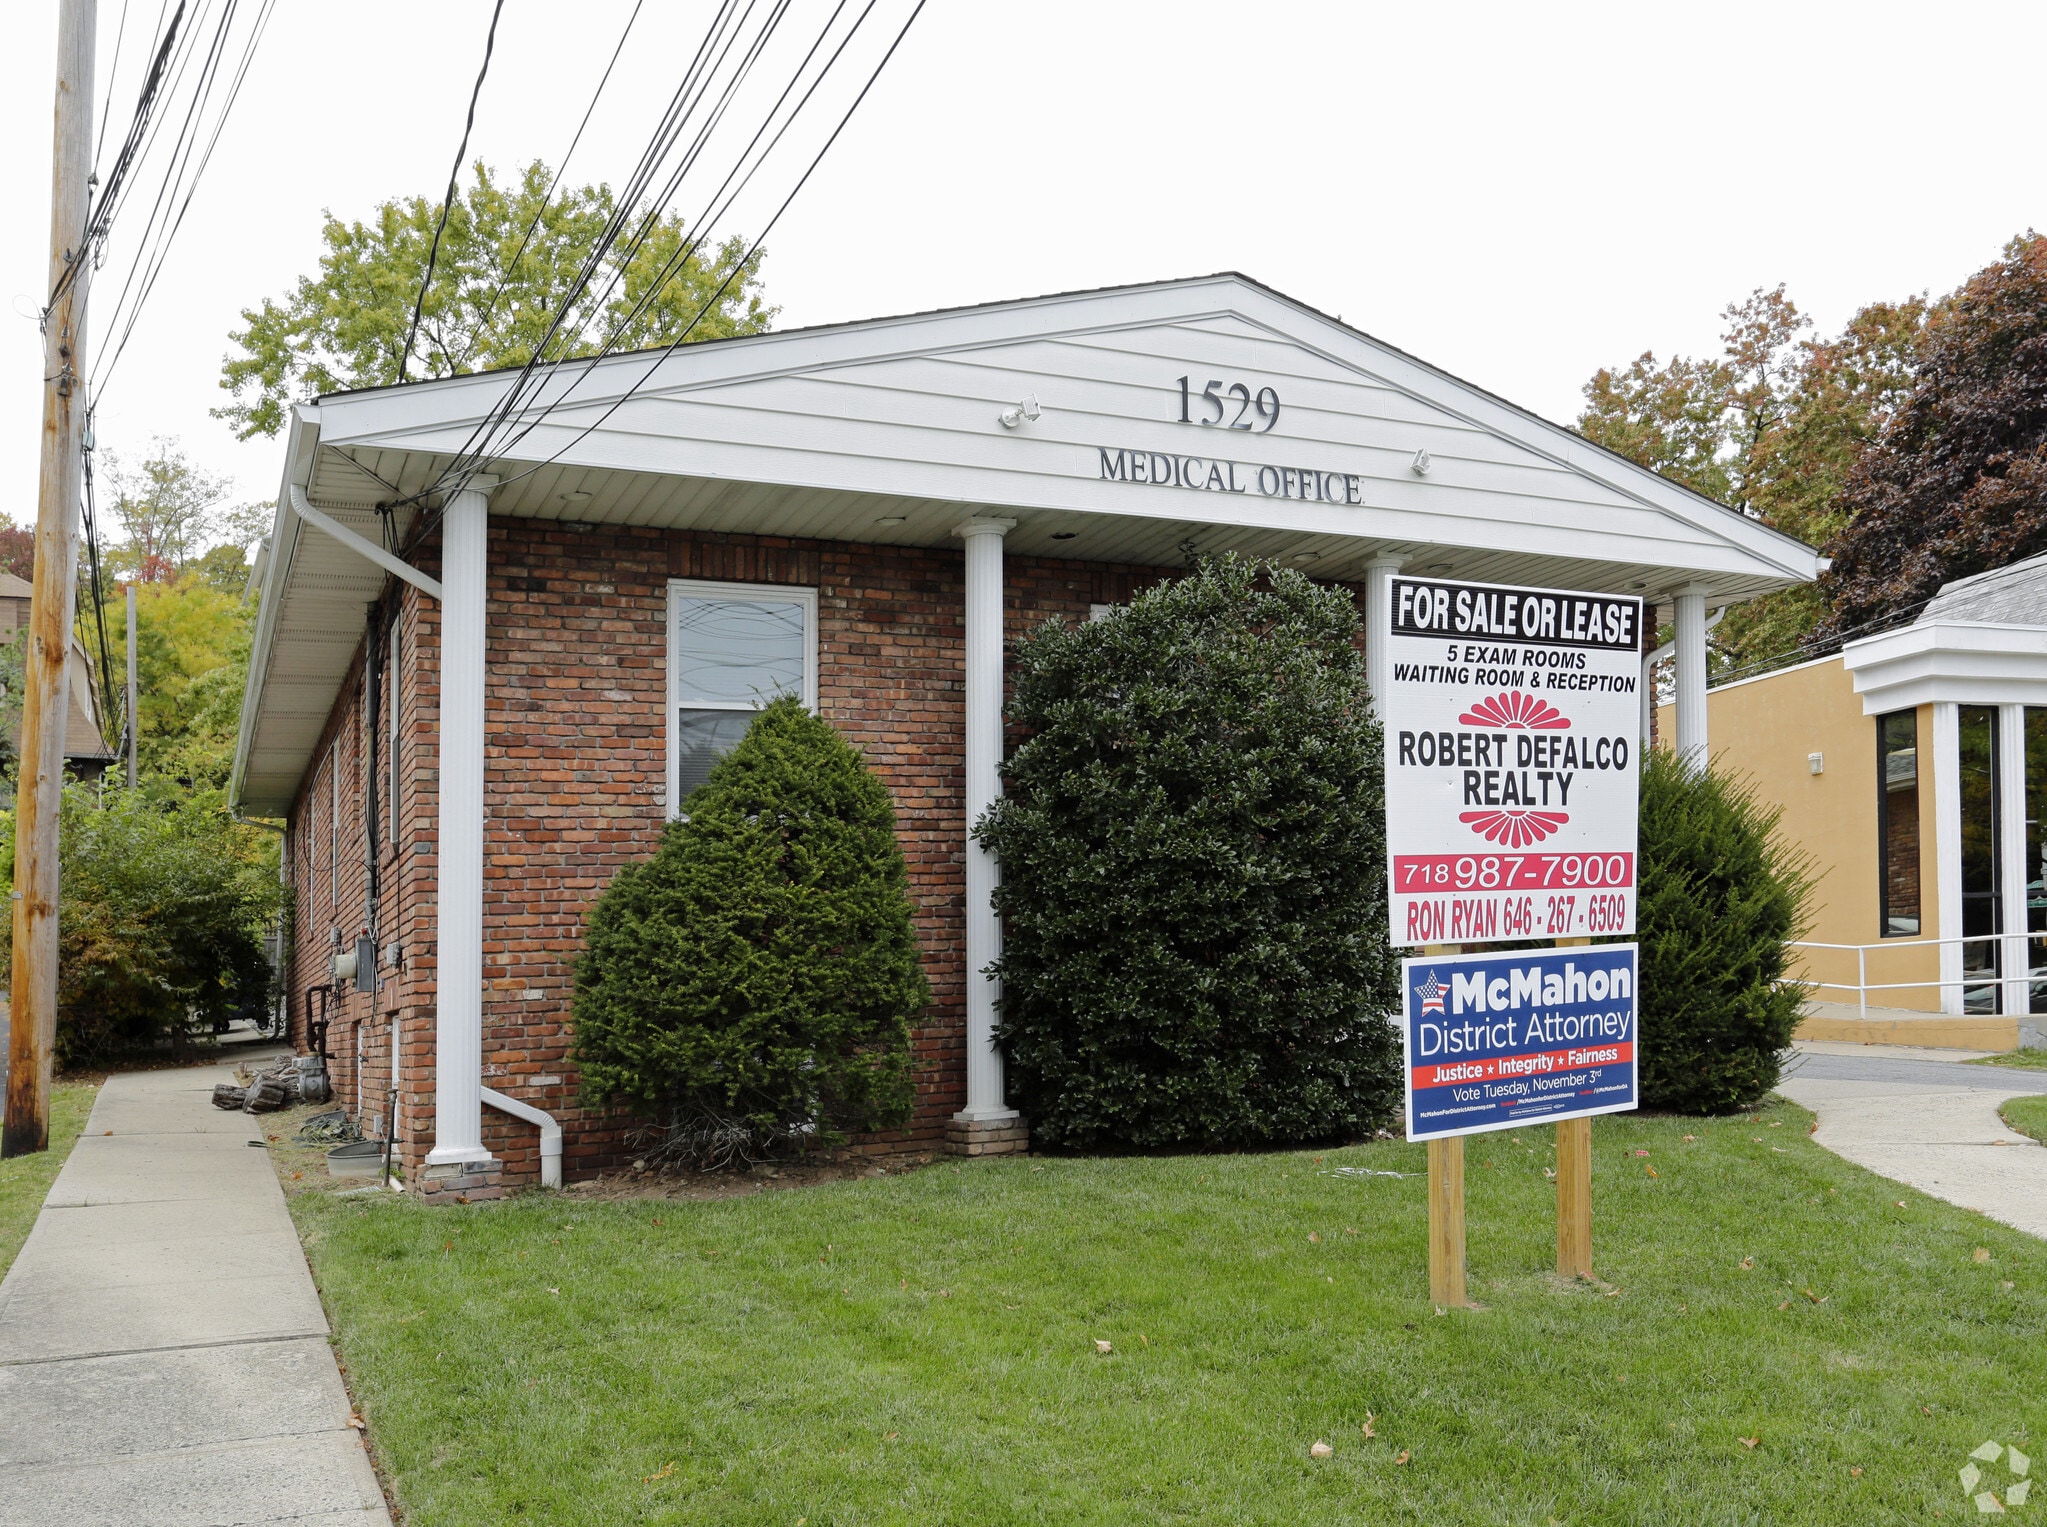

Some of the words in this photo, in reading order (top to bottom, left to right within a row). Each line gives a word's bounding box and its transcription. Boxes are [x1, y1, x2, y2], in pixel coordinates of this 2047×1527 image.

[1177, 375, 1281, 434] 1529
[1098, 447, 1246, 493] MEDICAL
[1258, 465, 1362, 504] OFFICE
[1399, 586, 1449, 629] FOR
[1455, 590, 1518, 635] SALE
[1522, 596, 1556, 637] OR
[1560, 600, 1633, 644] LEASE
[1447, 645, 1458, 661] 5
[1464, 645, 1517, 665] EXAM
[1522, 650, 1586, 669] ROOMS
[1394, 664, 1469, 684] WAITING
[1475, 668, 1524, 687] ROOM
[1530, 672, 1540, 687] &
[1546, 673, 1635, 693] RECEPTION
[1400, 731, 1508, 767] ROBERT
[1517, 734, 1628, 770] DEFALCO
[1464, 770, 1573, 806] REALTY
[1403, 863, 1449, 885] 718
[1455, 855, 1625, 889] 987-7900
[1407, 900, 1445, 941] RON
[1451, 899, 1497, 939] RYAN
[1452, 963, 1631, 1015] McMahon
[1420, 1017, 1517, 1056] District
[1524, 1011, 1631, 1044] Attorney
[1433, 1063, 1483, 1083] Justice
[1498, 1055, 1554, 1075] Integrity
[1568, 1048, 1617, 1065] Fairness
[1453, 1086, 1480, 1102] Vote
[1484, 1081, 1530, 1099] Tuesday,
[1533, 1072, 1586, 1091] November
[1589, 1069, 1602, 1084] 3rd
